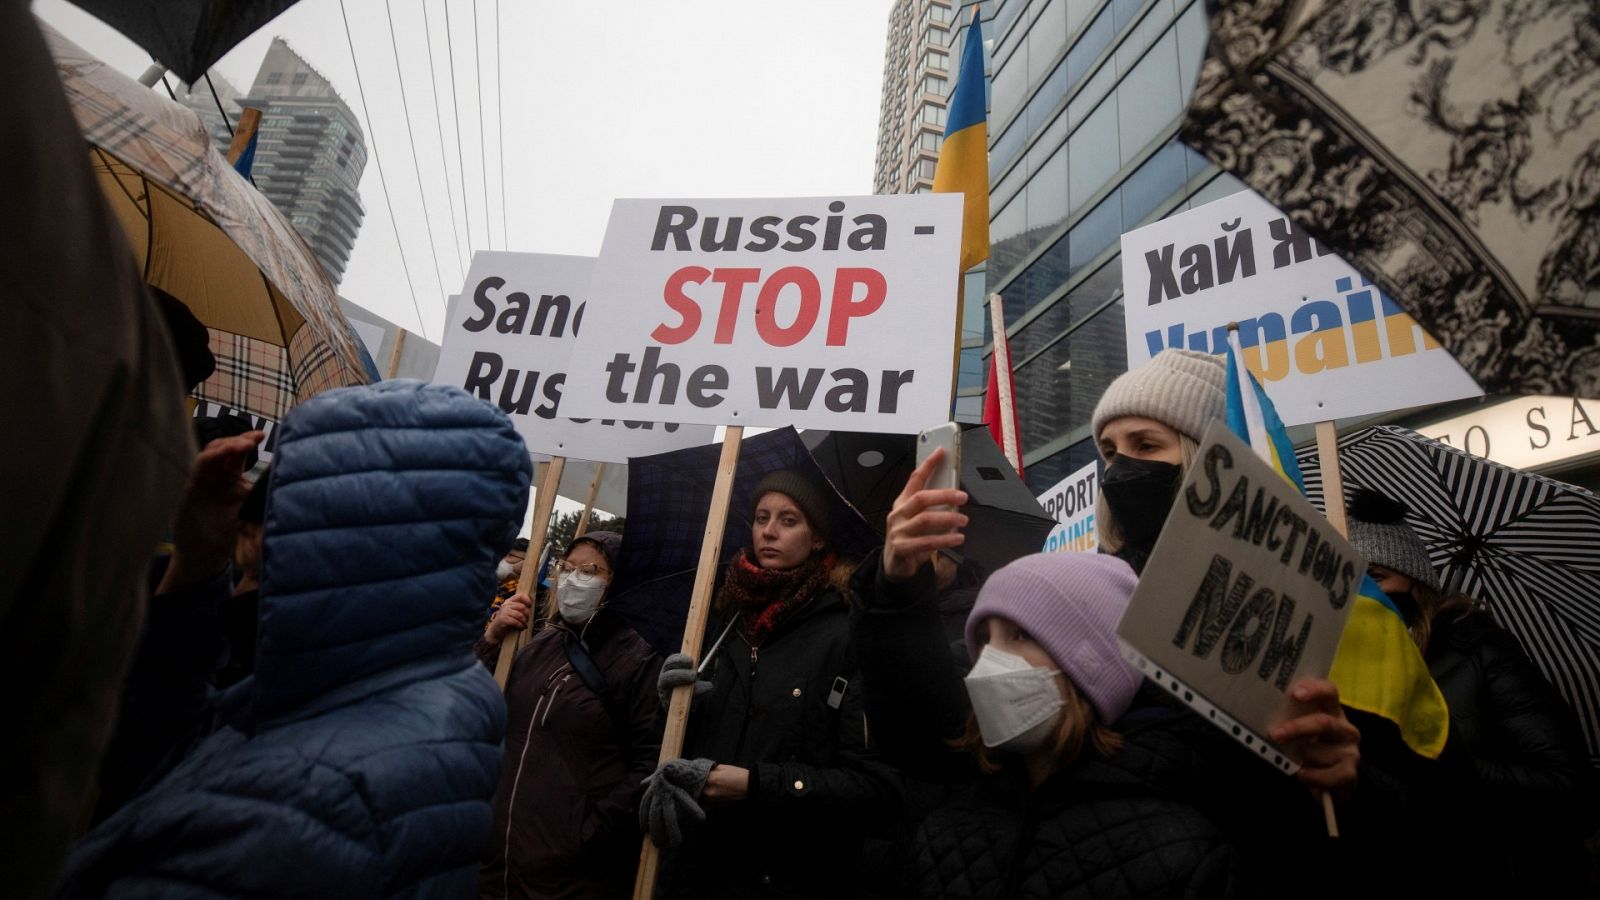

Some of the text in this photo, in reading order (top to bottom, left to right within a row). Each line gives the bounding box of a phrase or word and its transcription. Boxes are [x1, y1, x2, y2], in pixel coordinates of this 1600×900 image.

[650, 201, 888, 252] Russia
[1144, 217, 1257, 306] Хай
[650, 265, 888, 347] STOP
[605, 346, 915, 414] the war
[1432, 425, 1491, 461] O
[1172, 553, 1314, 694] NOW
